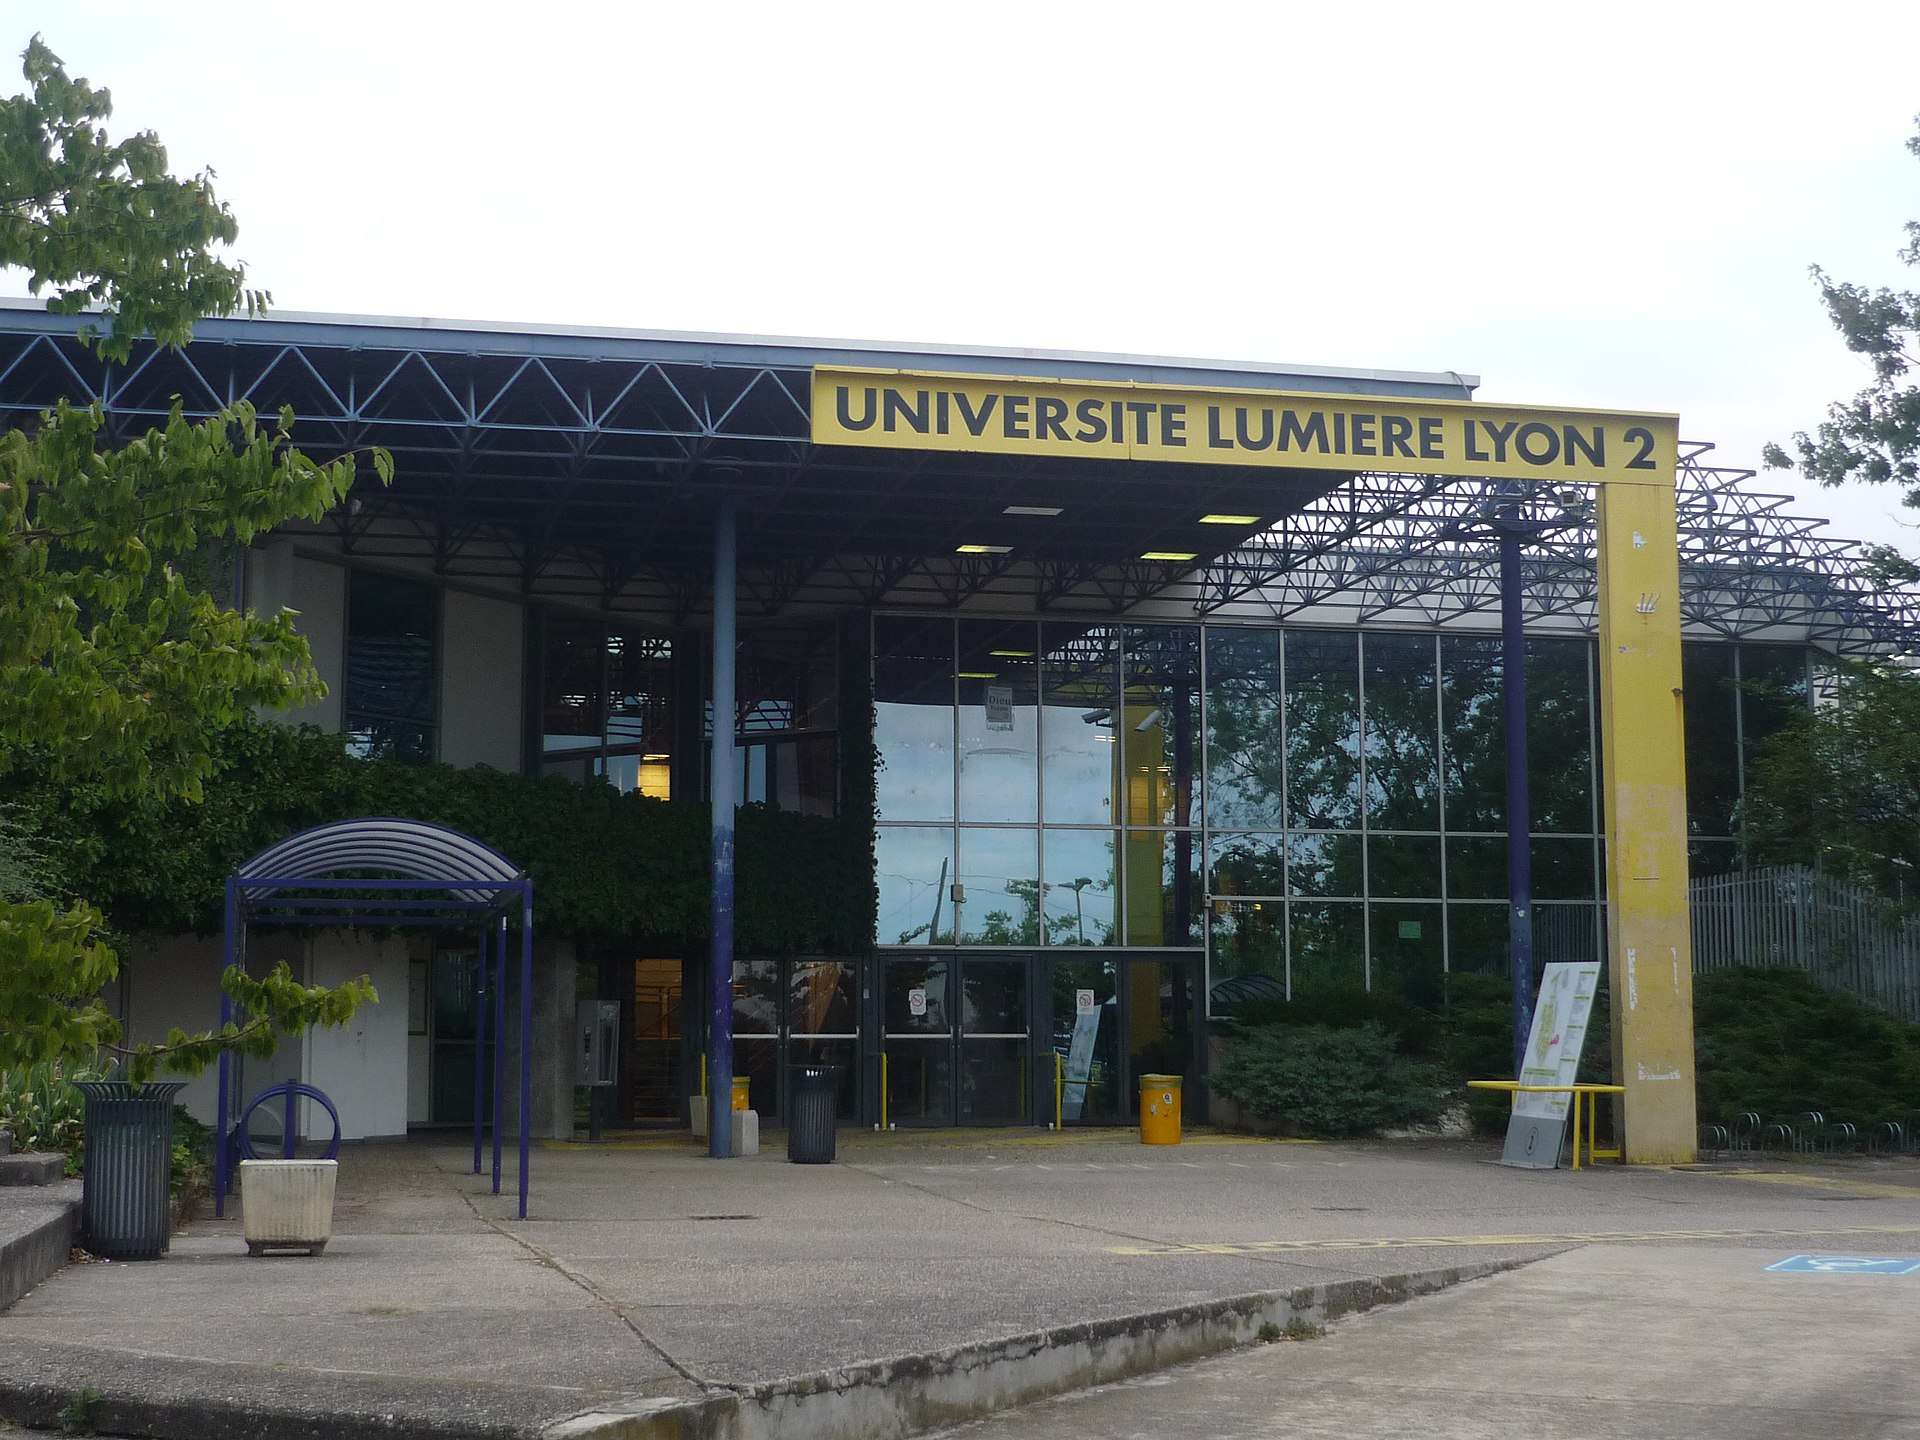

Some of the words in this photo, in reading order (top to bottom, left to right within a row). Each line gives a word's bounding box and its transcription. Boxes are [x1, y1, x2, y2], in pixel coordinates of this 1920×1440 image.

[836, 385, 1187, 447] UNIVERSITE
[1207, 405, 1445, 460] LUMIERE
[1463, 419, 1606, 468] LYON
[1623, 426, 1657, 470] 2
